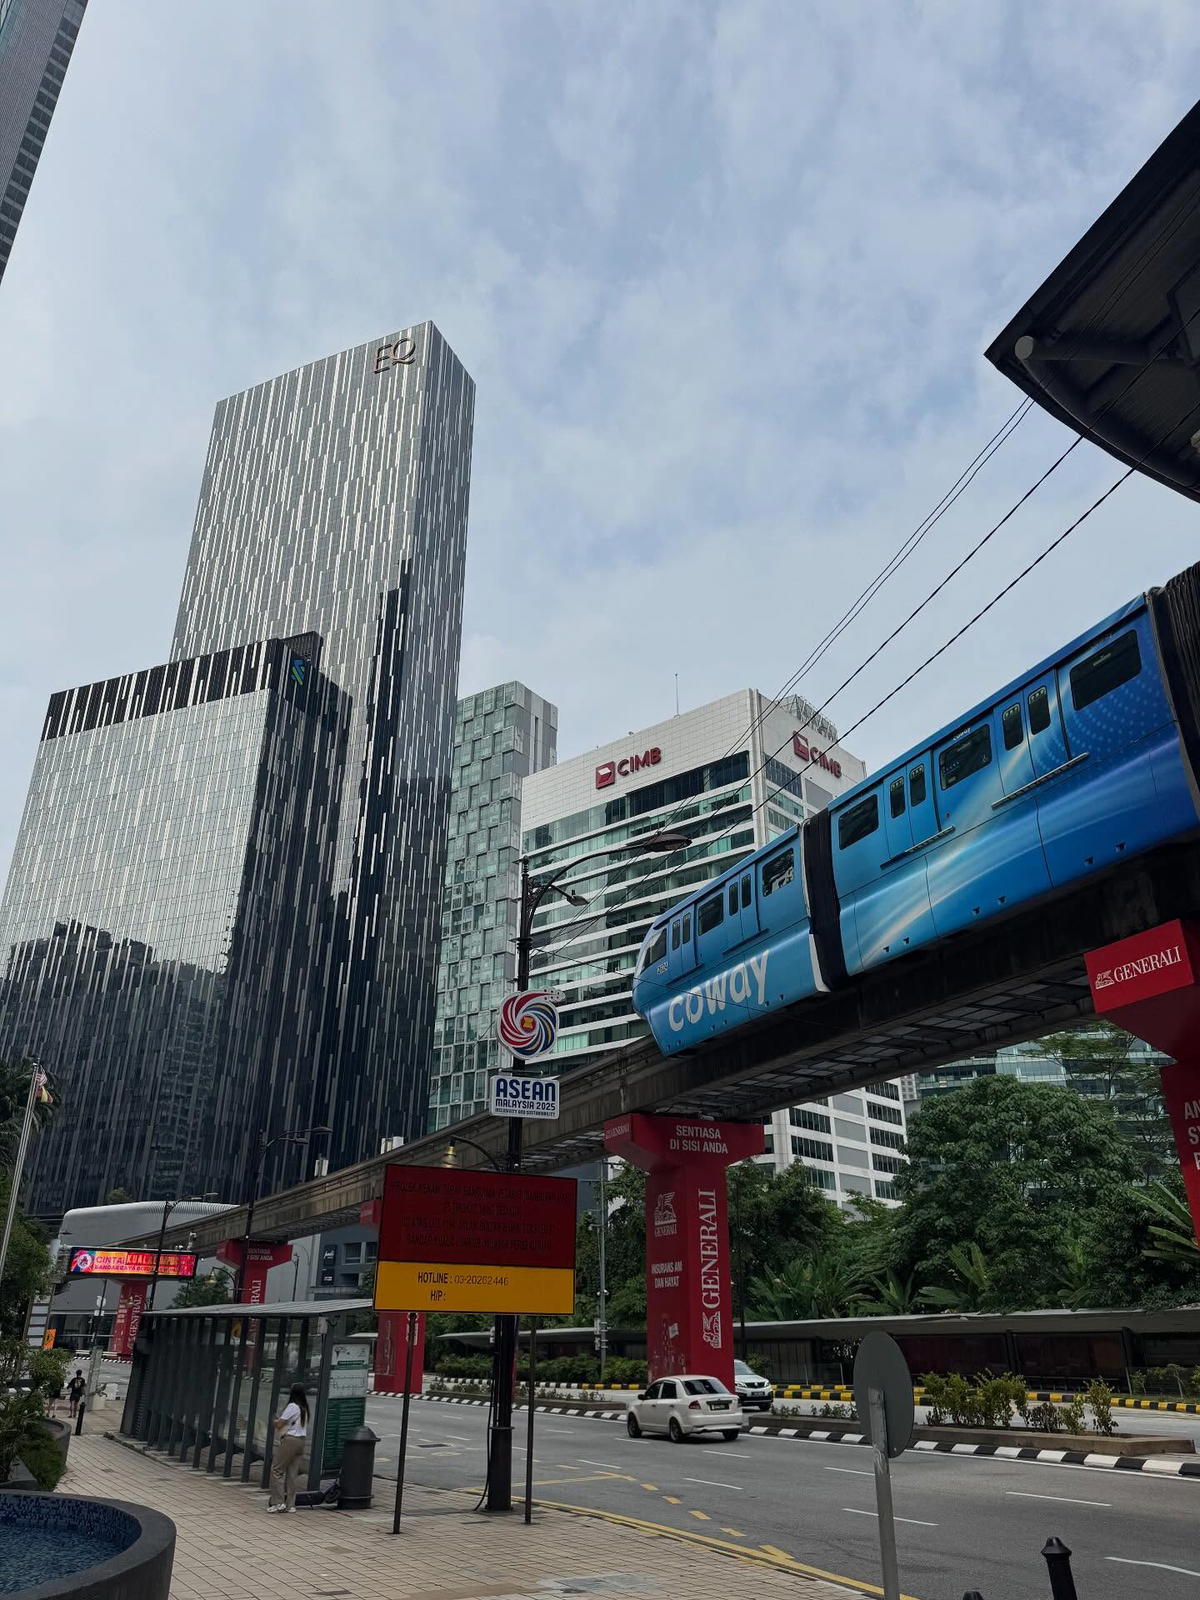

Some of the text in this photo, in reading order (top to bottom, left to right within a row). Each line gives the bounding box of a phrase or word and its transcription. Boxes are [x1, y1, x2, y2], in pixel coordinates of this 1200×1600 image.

[374, 337, 416, 374] EQ
[617, 746, 662, 777] CIMB
[810, 746, 842, 779] CIMB
[1113, 945, 1182, 983] GENERALI
[668, 949, 769, 1032] coway
[495, 1078, 555, 1101] ASEAN
[495, 1098, 556, 1111] MALAYSIA 2025
[676, 1124, 722, 1140] SENTIASA
[669, 1138, 729, 1154] DI SISI ANDA
[698, 1188, 721, 1310] GENERALI
[418, 1272, 448, 1284] HOTLINE
[651, 1260, 683, 1275] INSURANS AM
[654, 1275, 680, 1288] DAN HAYAT
